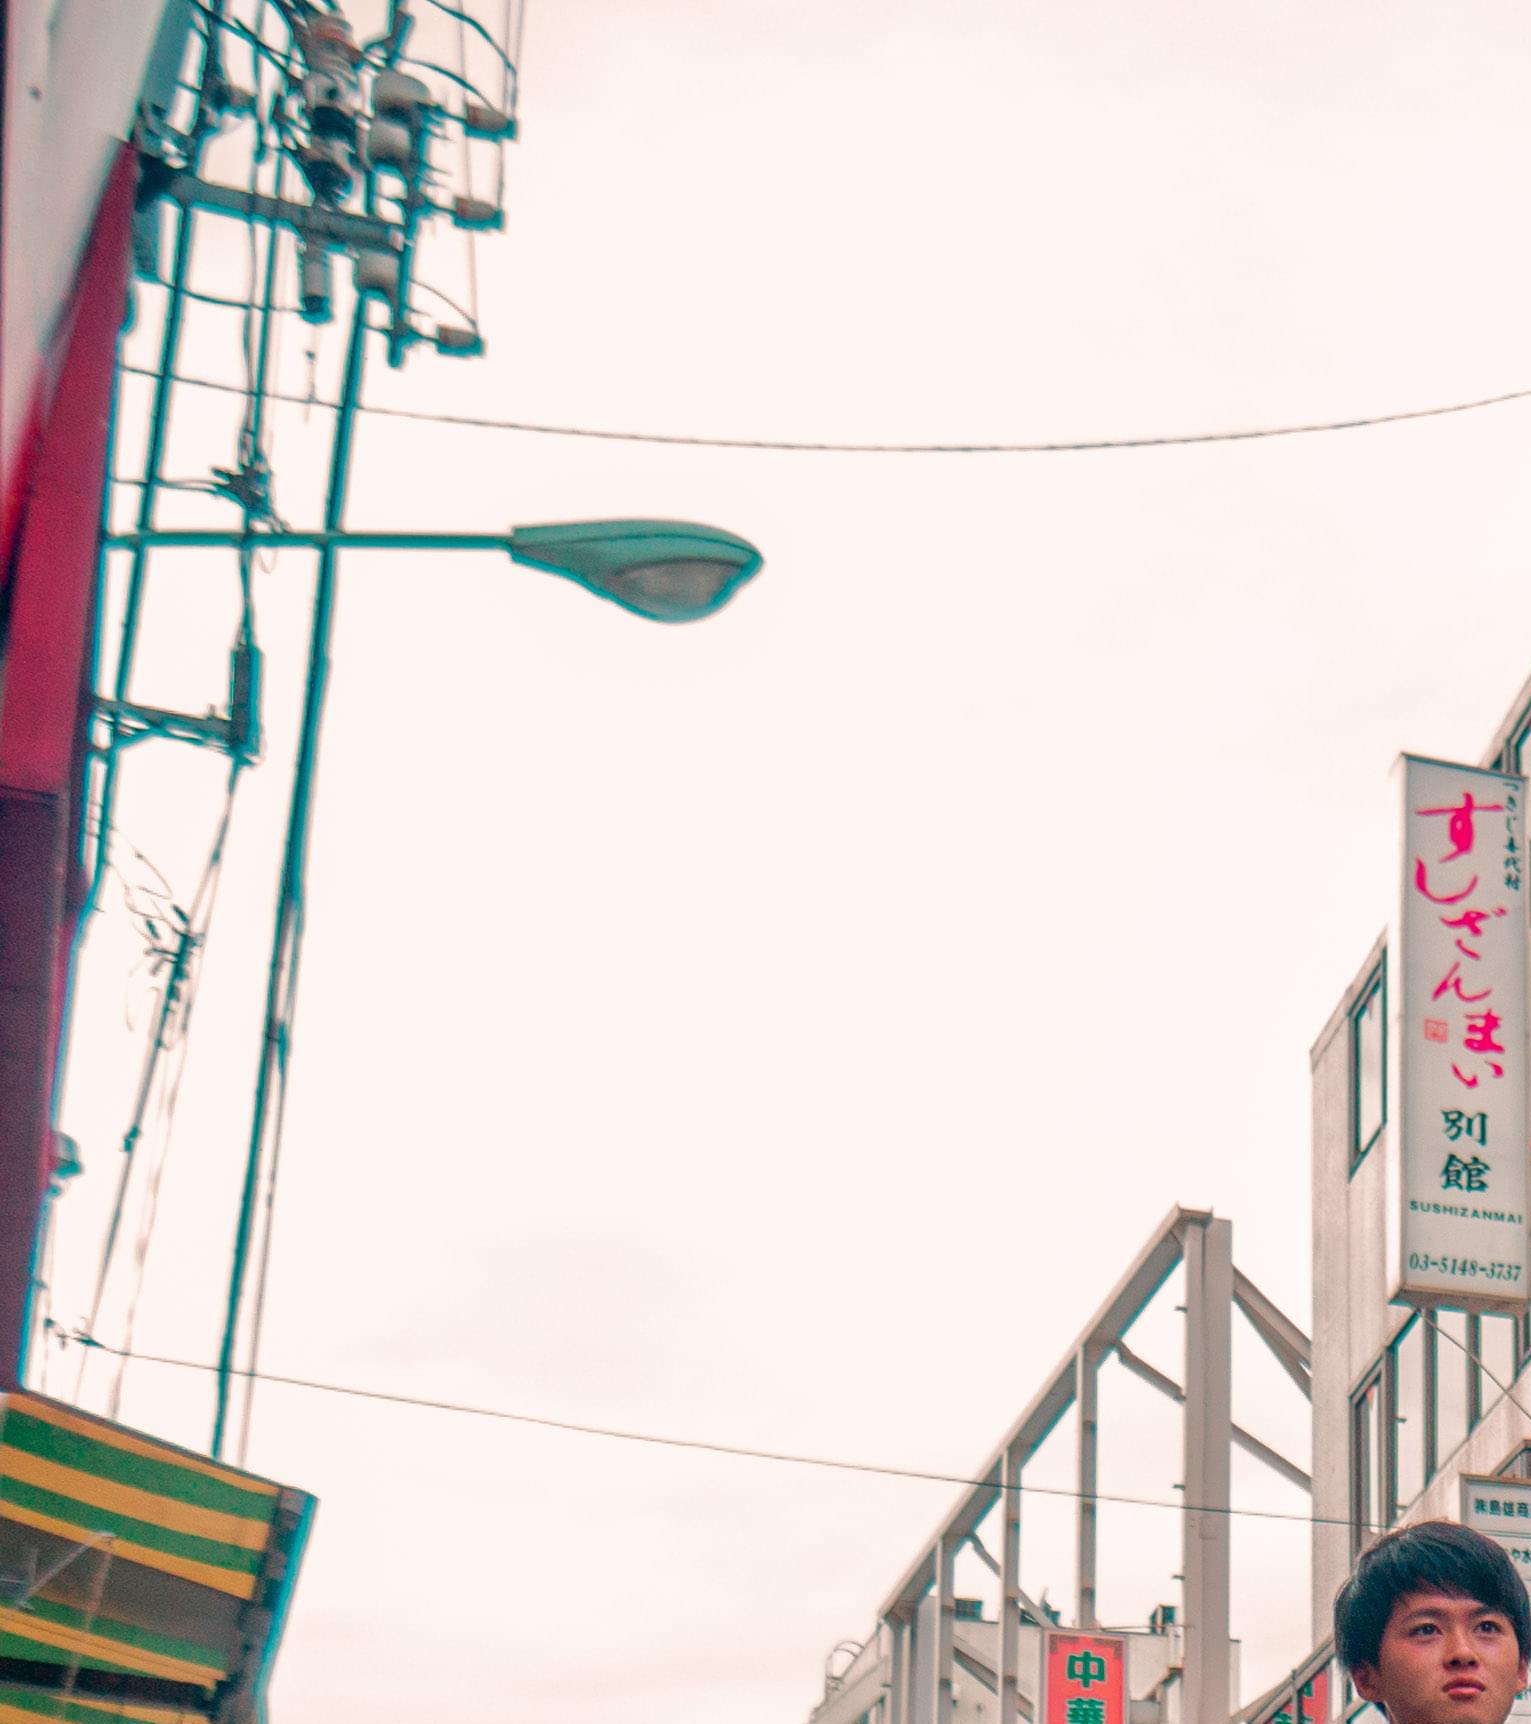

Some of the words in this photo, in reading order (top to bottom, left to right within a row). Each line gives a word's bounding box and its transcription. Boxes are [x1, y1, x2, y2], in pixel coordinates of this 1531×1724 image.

[1414, 791, 1507, 1089] すしざんまい
[1440, 1108, 1490, 1193] 別館
[1409, 1200, 1523, 1224] SUSHIZANMAI
[1409, 1252, 1522, 1282] 03-5148-3737
